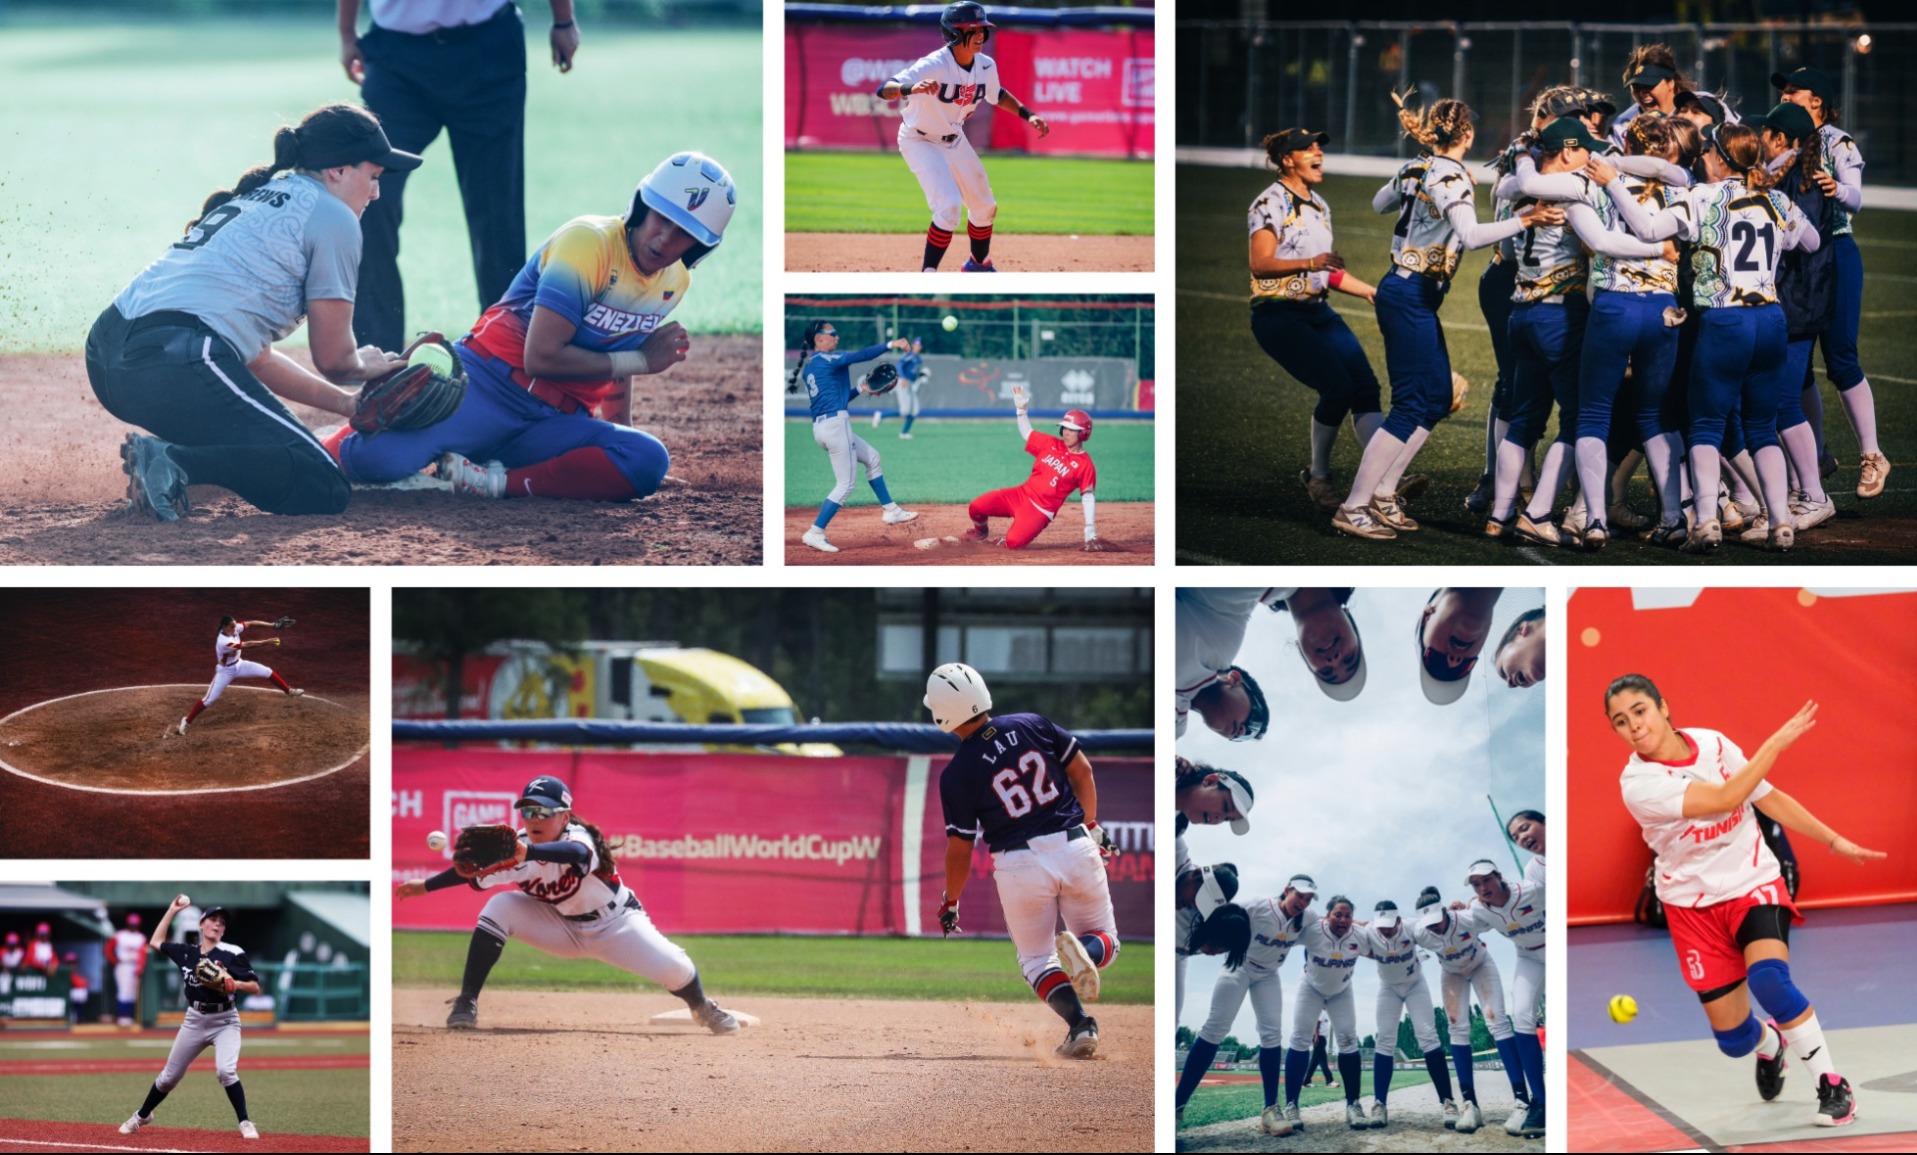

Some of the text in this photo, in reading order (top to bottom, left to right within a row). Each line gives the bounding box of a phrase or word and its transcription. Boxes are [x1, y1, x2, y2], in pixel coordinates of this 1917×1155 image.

[1034, 57, 1112, 79] WATCH
[1034, 81, 1082, 103] LIVE
[173, 205, 242, 250] 9
[1732, 221, 1775, 271] 21
[807, 373, 819, 398] 3
[1041, 454, 1069, 479] JAPAN
[1049, 476, 1058, 488] 5
[972, 705, 978, 714] 6
[982, 730, 1019, 765] LAU
[993, 749, 1060, 818] 62
[610, 834, 882, 866] #BaseballWorldCupW
